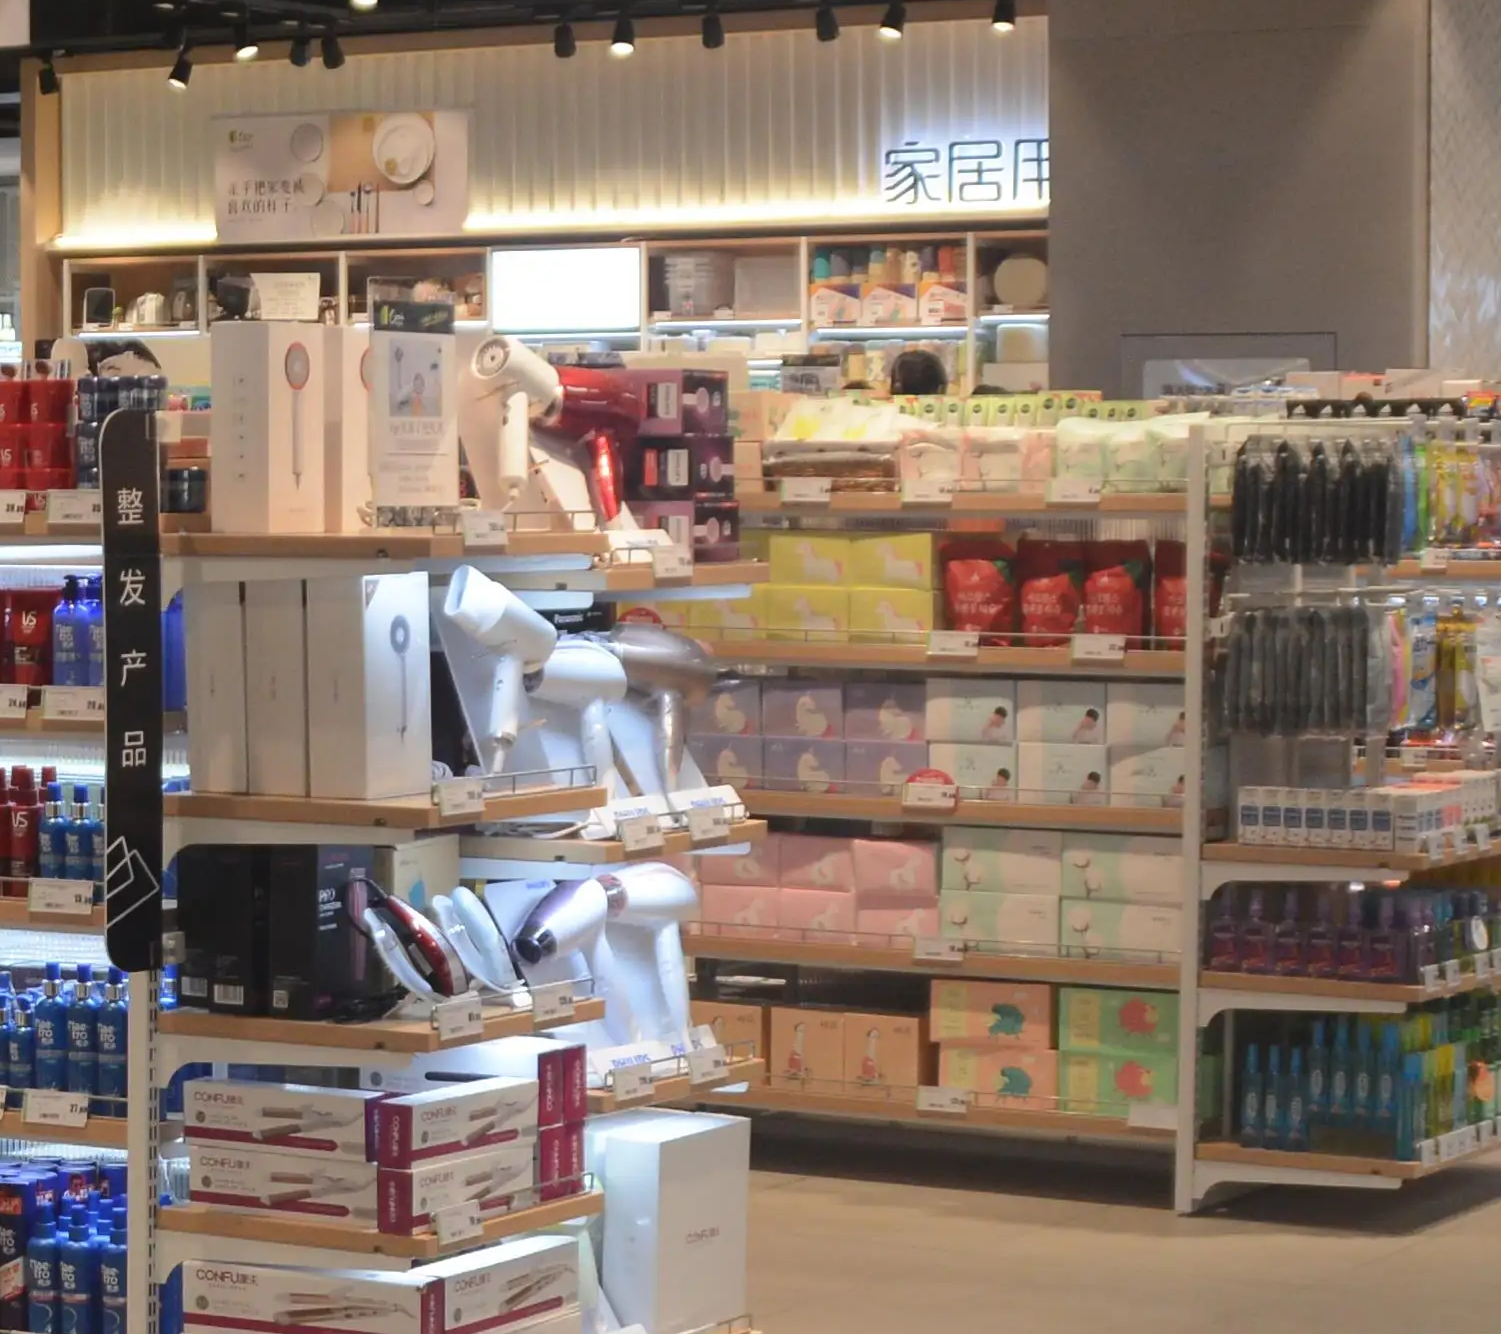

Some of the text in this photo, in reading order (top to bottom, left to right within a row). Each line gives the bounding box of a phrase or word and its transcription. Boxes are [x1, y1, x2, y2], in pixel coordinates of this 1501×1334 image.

[116, 487, 148, 768] 整发产品
[11, 810, 29, 829] VS
